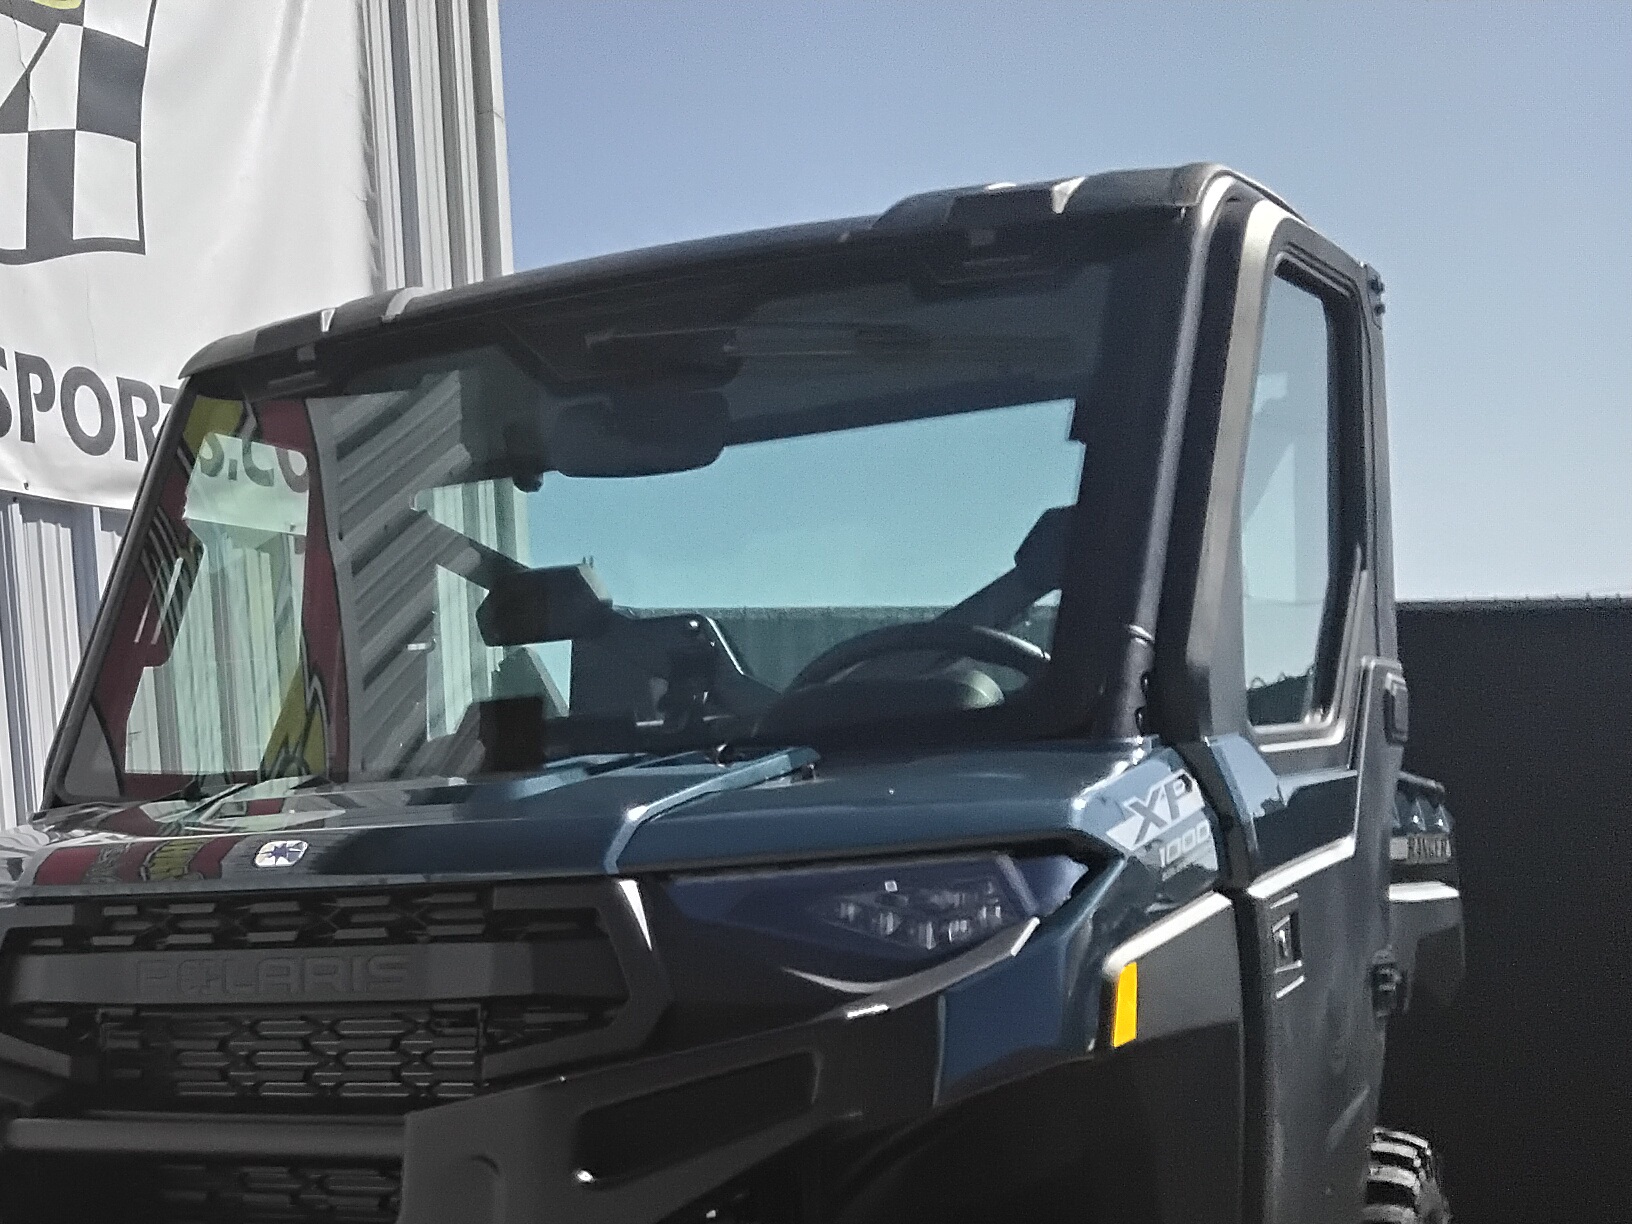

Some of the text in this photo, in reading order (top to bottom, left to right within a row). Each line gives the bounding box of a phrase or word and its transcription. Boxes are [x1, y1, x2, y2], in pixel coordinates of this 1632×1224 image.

[1128, 772, 1194, 846] XP
[1159, 819, 1210, 868] 1000
[136, 954, 411, 995] POLARIS
